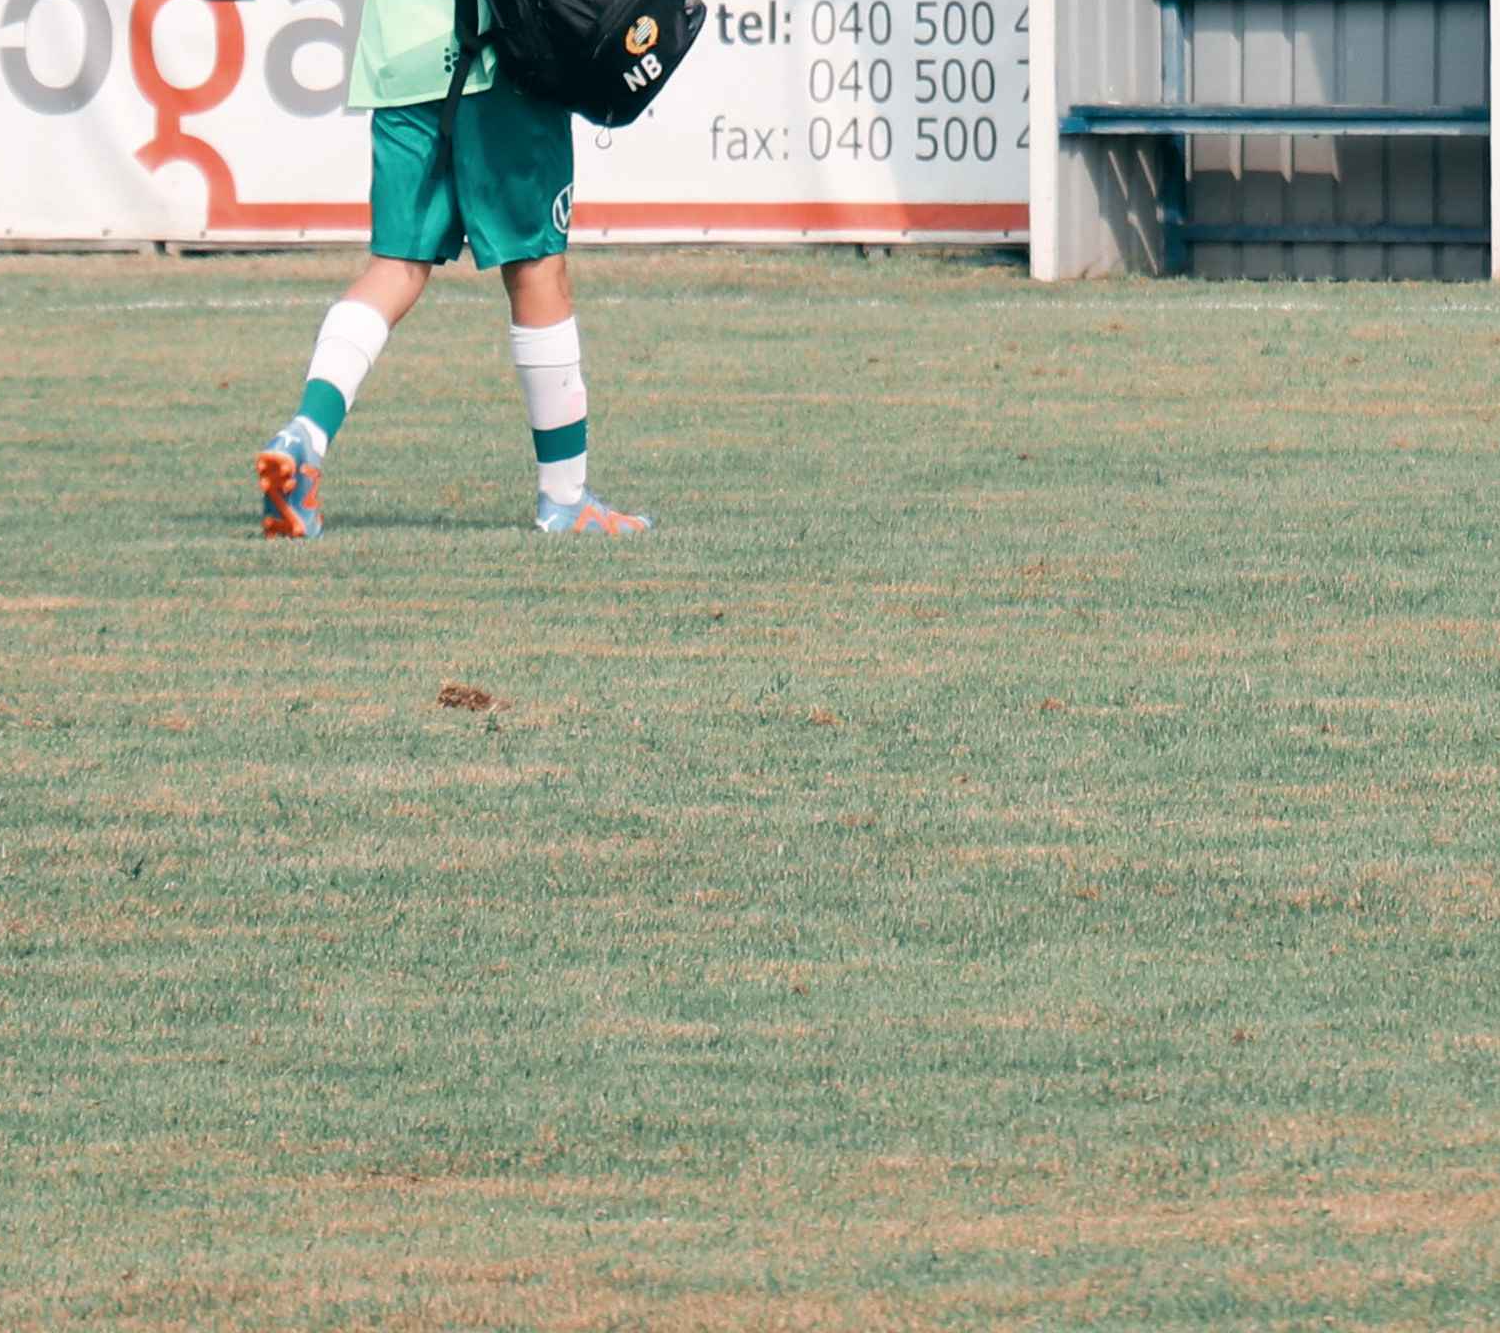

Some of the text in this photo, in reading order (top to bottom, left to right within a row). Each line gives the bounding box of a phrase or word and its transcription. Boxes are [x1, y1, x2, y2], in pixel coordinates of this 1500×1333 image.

[717, 0, 792, 46] tel:
[809, 0, 893, 47] 040
[914, 0, 995, 47] 500
[623, 52, 665, 93] NB
[808, 59, 892, 105] 040
[915, 58, 996, 105] 500
[710, 114, 790, 162] fax:
[808, 117, 893, 162] 040
[915, 116, 996, 162] 500
